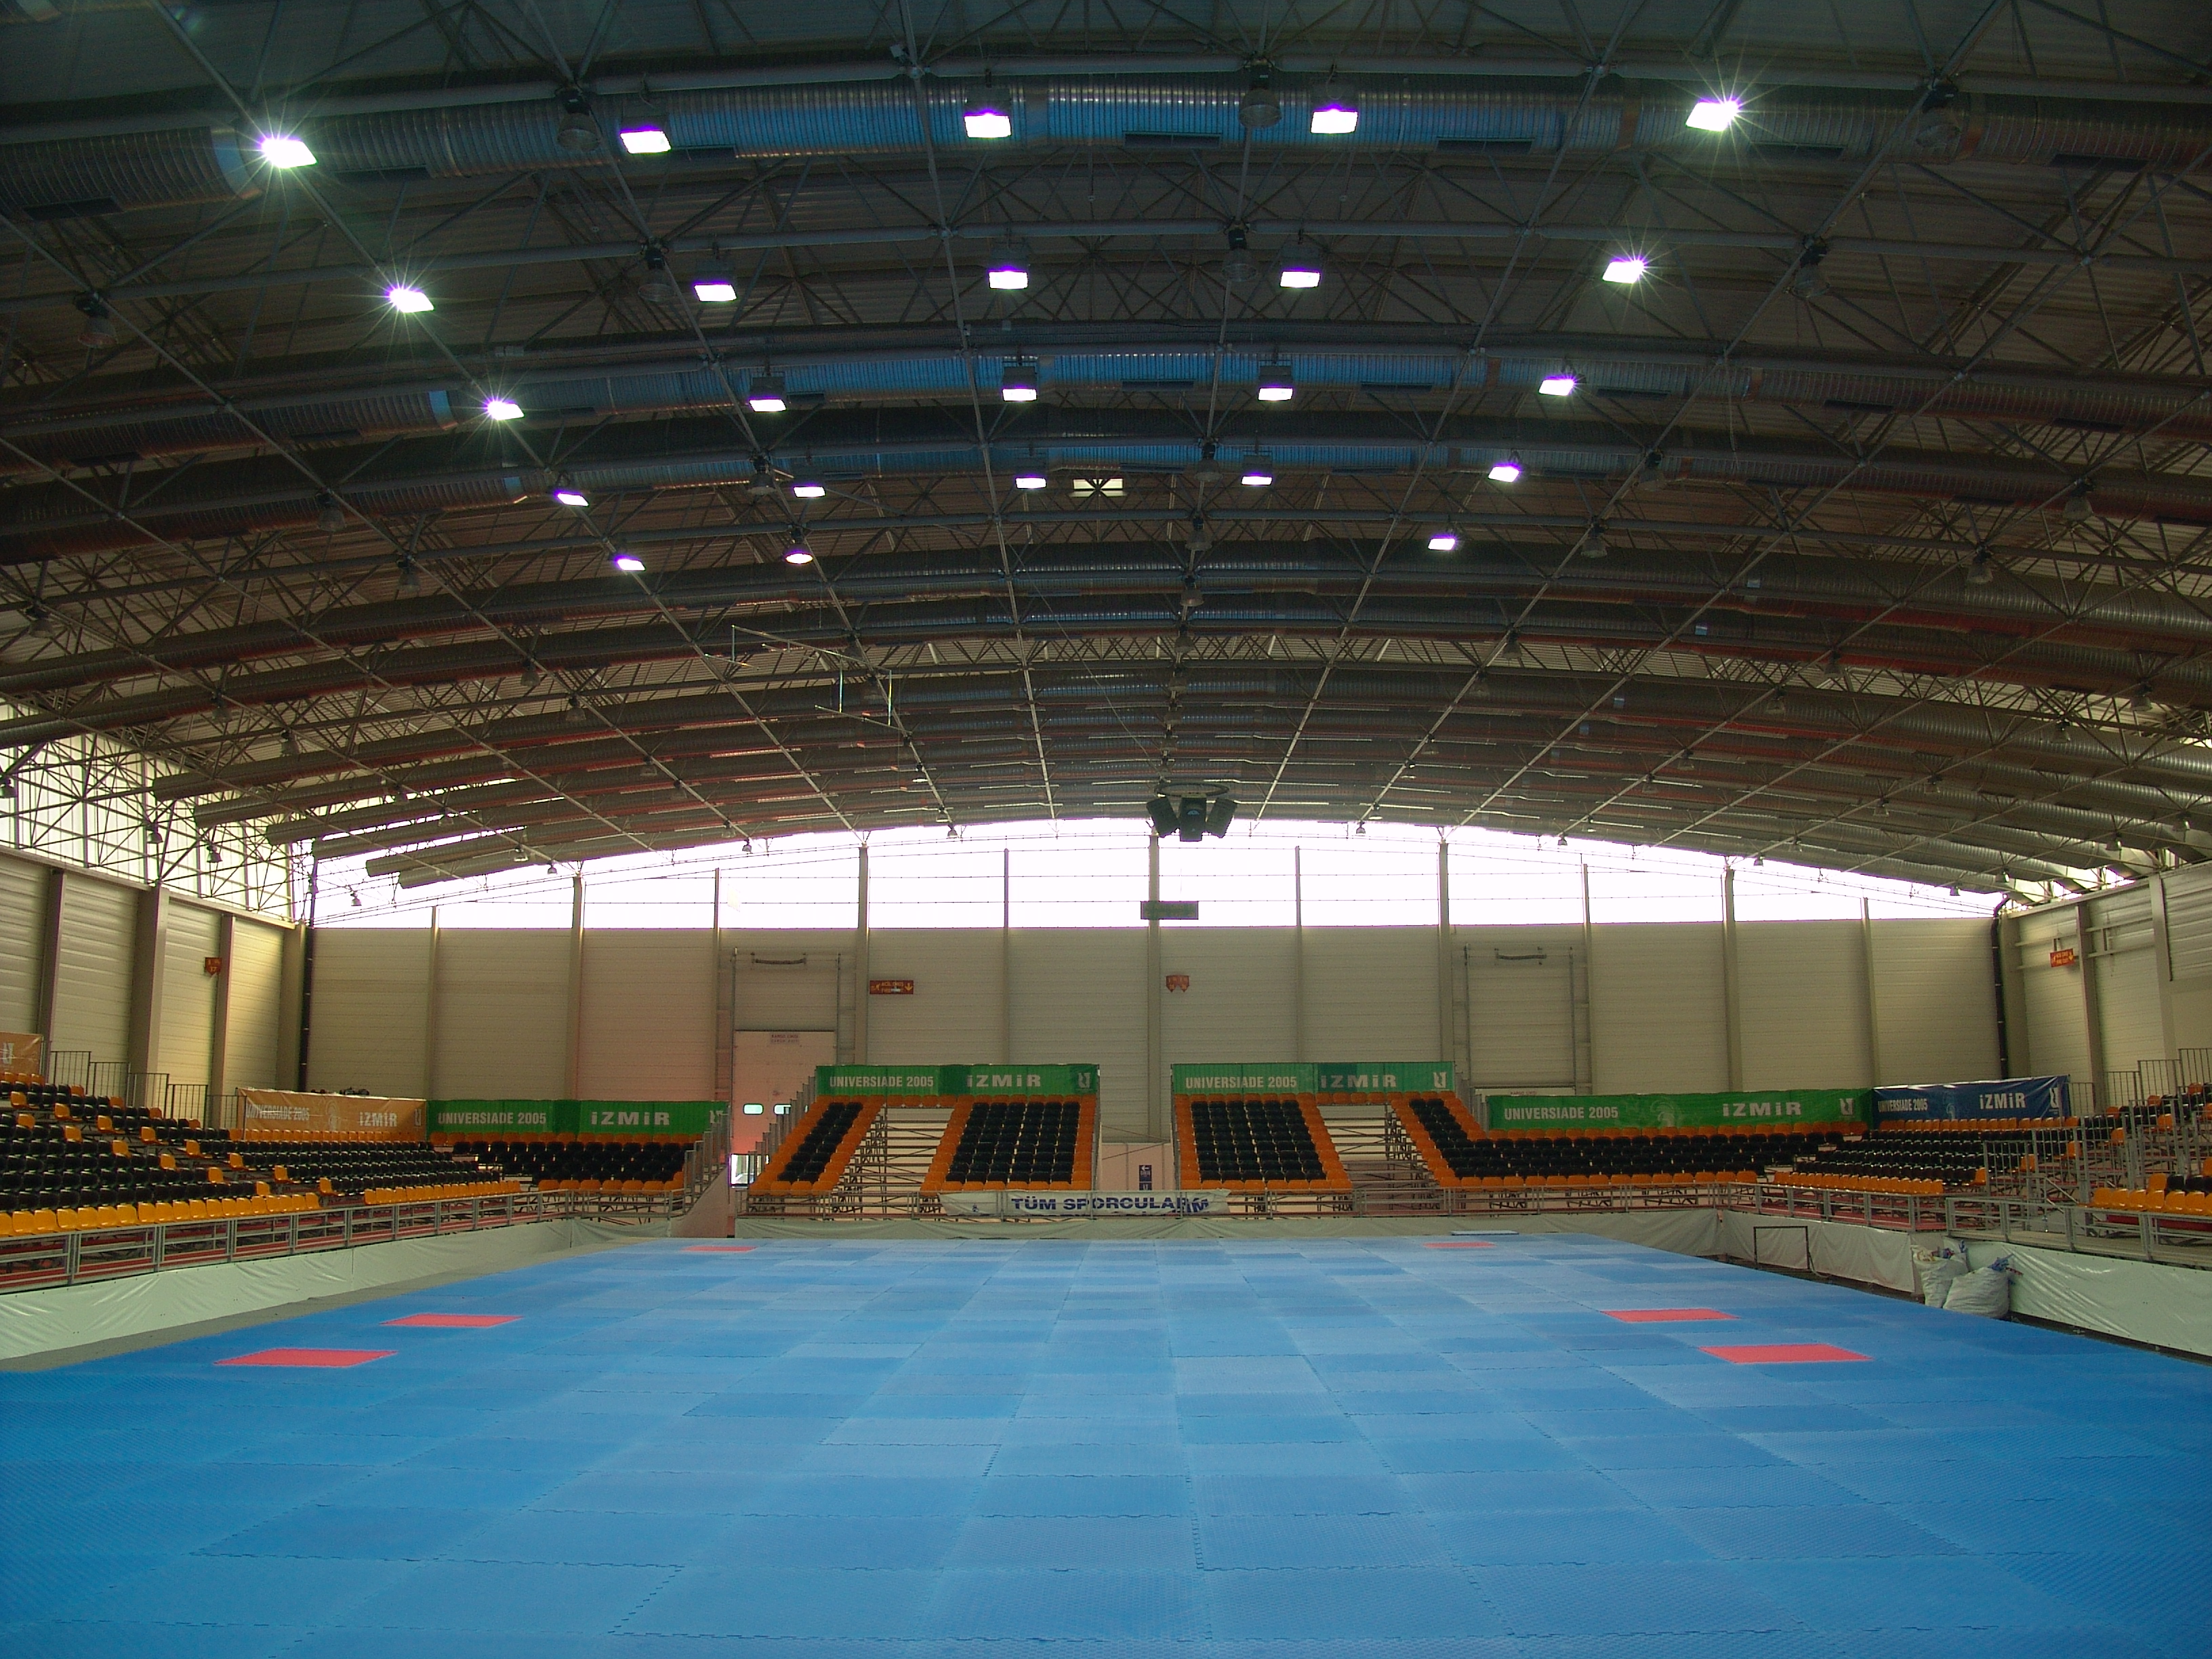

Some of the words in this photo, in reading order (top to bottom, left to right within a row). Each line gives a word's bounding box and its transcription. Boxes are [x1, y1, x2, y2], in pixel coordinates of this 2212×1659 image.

[830, 1076, 902, 1088] UNIVERSIADE
[907, 1076, 934, 1088] 2005
[1185, 1076, 1264, 1089] UNIVERSIADE
[1268, 1076, 1297, 1088] 2005
[437, 1112, 514, 1125] UNIVERSIADE
[518, 1112, 546, 1125] 2005
[1504, 1106, 1585, 1120] UNIVERSIADE
[1589, 1105, 1618, 1119] 2005
[1011, 1196, 1056, 1210] TÜM
